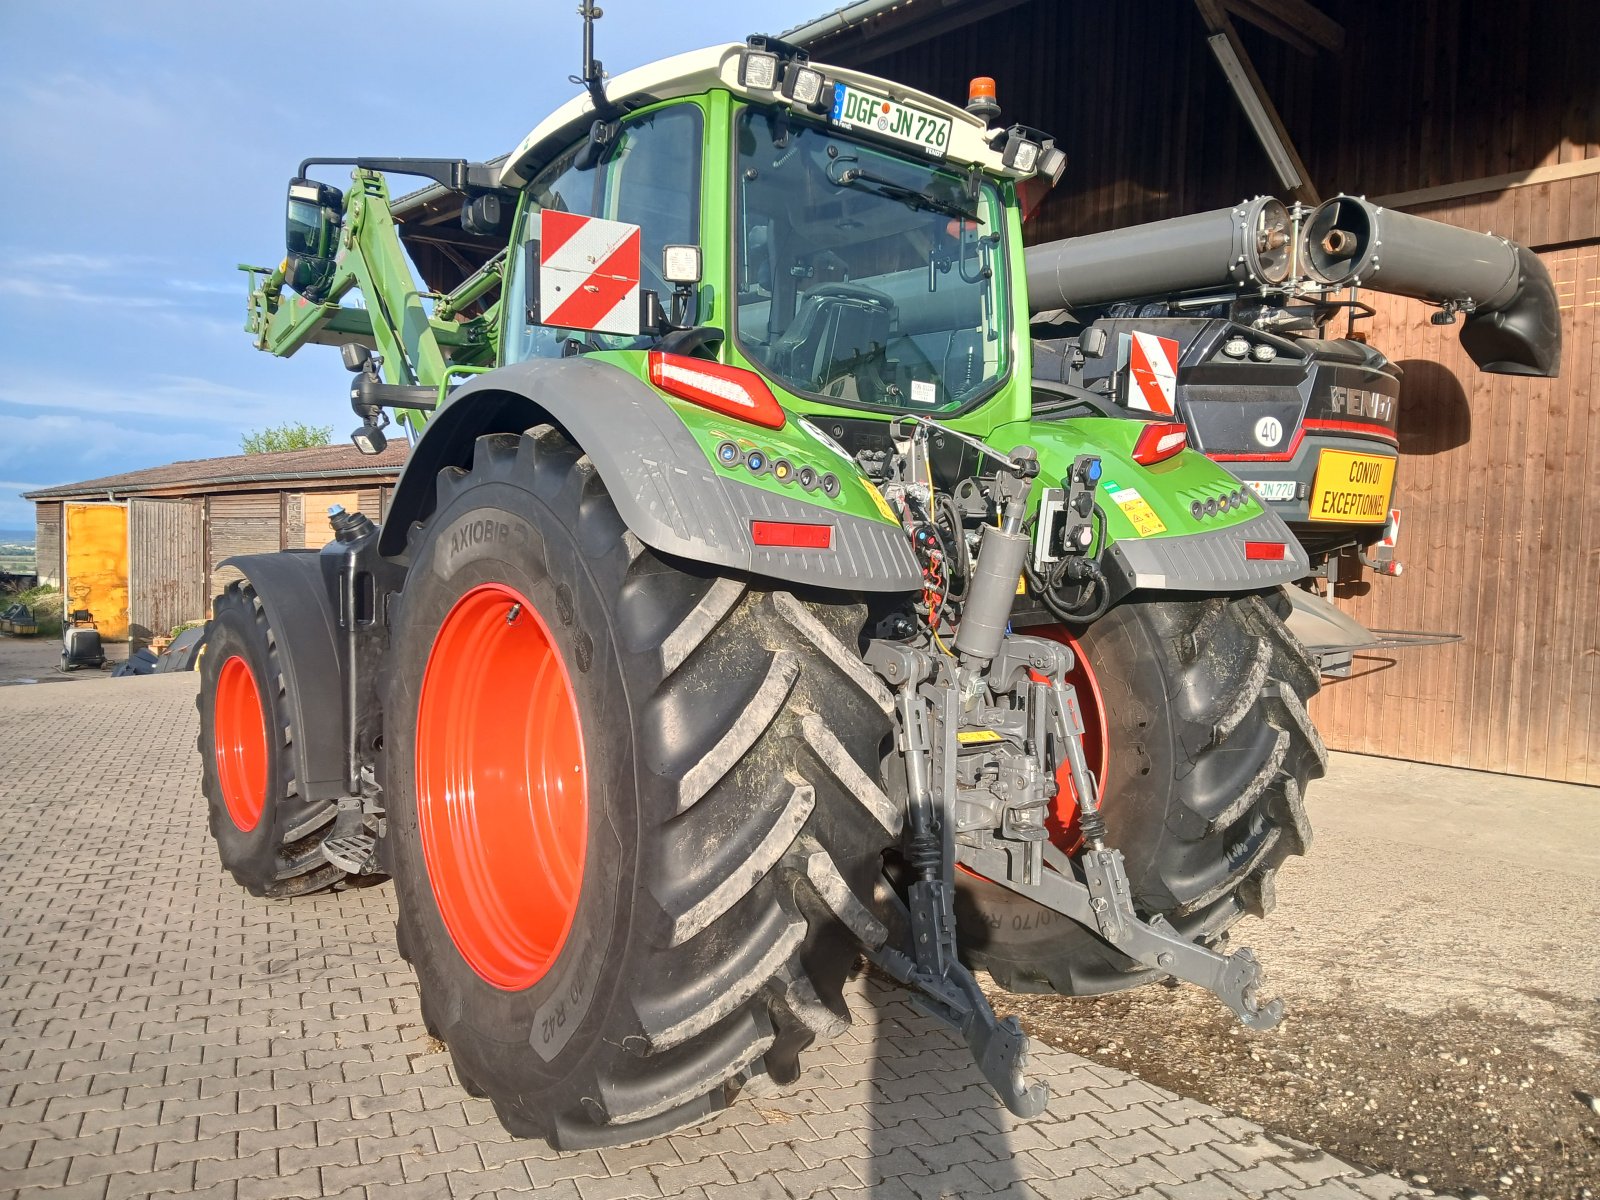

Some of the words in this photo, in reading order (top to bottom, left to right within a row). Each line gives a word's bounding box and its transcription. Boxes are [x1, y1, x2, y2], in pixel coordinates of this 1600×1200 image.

[844, 92, 882, 125] DGF
[889, 108, 914, 138] JN
[915, 116, 946, 147] 726
[1330, 385, 1395, 422] FENDT
[1261, 422, 1277, 442] 40
[1349, 461, 1382, 485] CONVOI
[1261, 483, 1275, 496] JN
[1321, 490, 1384, 517] EXCEPTIONNEL
